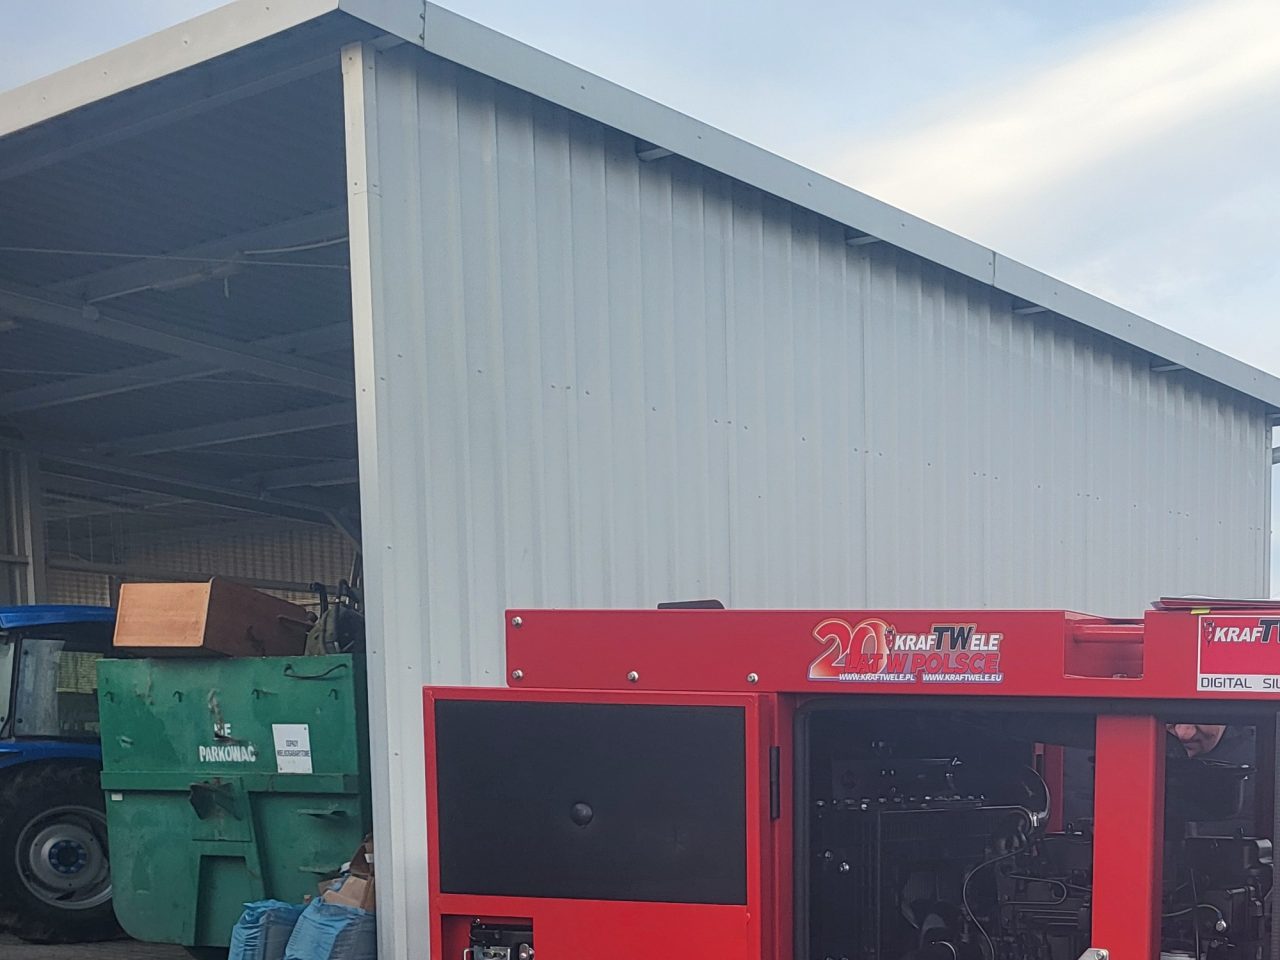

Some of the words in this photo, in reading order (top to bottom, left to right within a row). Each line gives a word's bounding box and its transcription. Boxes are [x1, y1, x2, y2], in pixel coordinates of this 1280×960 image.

[895, 626, 1000, 650] KRAFTWELE
[809, 618, 889, 679] 20
[912, 653, 999, 674] POLSCE
[839, 673, 915, 681] WWW.KRAFTWELE.PL
[922, 674, 1003, 682] WWW.KRAFTWELE.EU
[1201, 677, 1252, 689] DIGITAL
[199, 742, 256, 762] PARKOWAĆ
